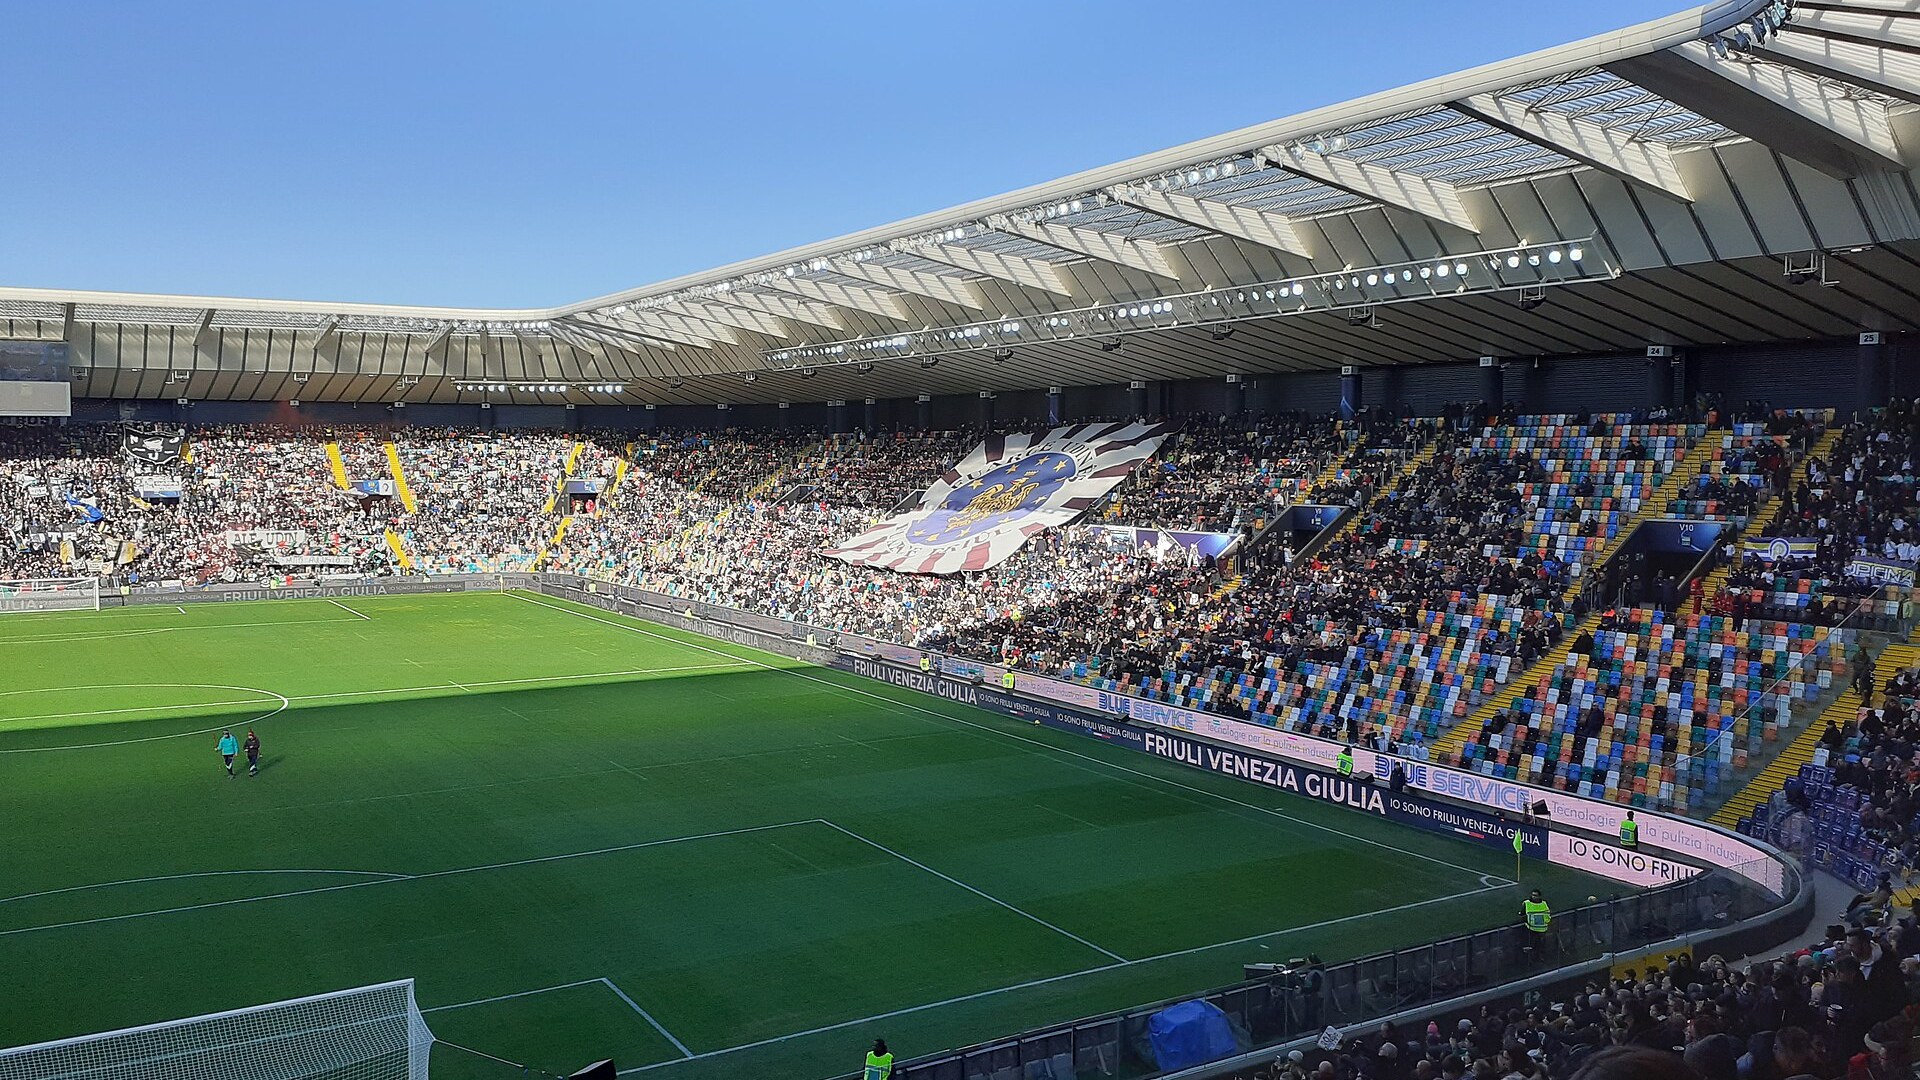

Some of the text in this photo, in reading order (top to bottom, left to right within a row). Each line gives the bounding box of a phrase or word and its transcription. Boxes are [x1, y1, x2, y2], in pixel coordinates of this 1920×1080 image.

[223, 585, 388, 602] FRIULI VENEZIA GIULIA
[854, 660, 886, 680] FRIULI
[887, 668, 934, 694] VENEZIA
[937, 680, 978, 705] GIULIA
[985, 694, 1000, 705] SONO
[1012, 702, 1034, 714] VENEZIA
[1034, 707, 1051, 718] GIULIA
[1056, 712, 1142, 742] IO SONO FRIULI VENEZIA GIULIA
[1098, 691, 1130, 713] BLUE
[1133, 701, 1194, 731] SERVICE
[1206, 720, 1246, 742] Tecnologie
[1145, 732, 1386, 815] FRIULI VENEZIA GIULIA
[1375, 754, 1427, 788] BUE
[1432, 769, 1530, 811] SERVICE
[1551, 800, 1616, 828] Tecnologie
[1390, 799, 1401, 810] IO
[1402, 802, 1431, 818] SONO
[1433, 809, 1460, 826] FRIULI
[1461, 816, 1504, 837] VENEZIA
[1645, 821, 1657, 837] la
[1662, 827, 1702, 849] pulizia
[1569, 838, 1587, 857] IO
[1592, 845, 1646, 872] SONO
